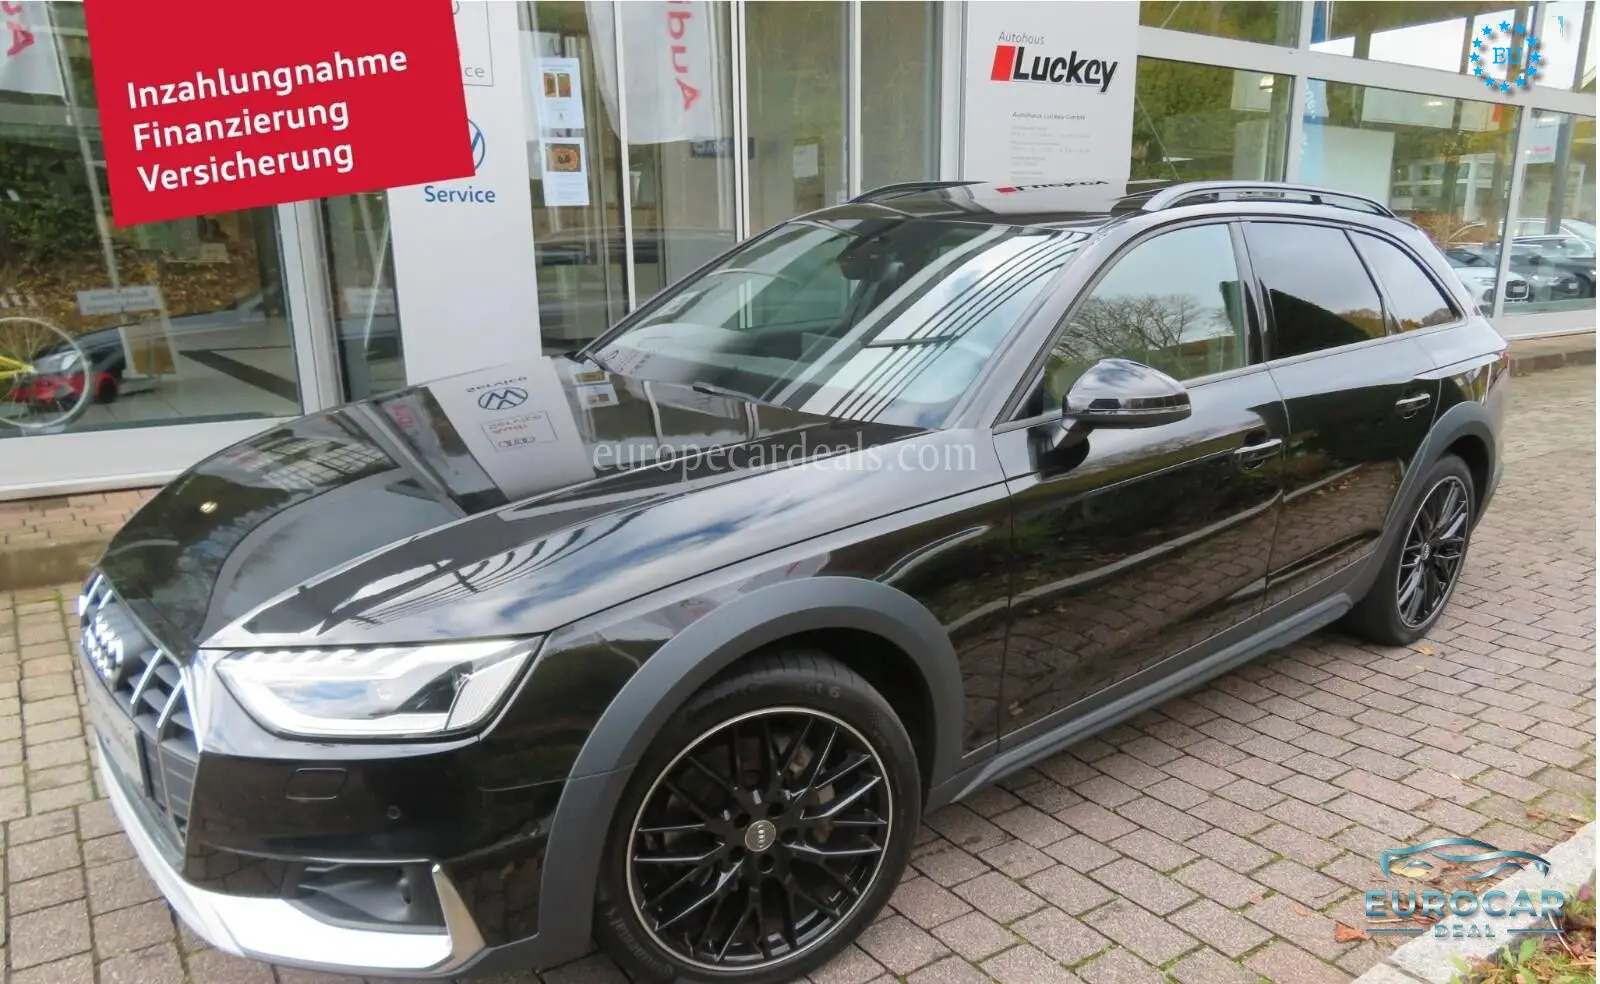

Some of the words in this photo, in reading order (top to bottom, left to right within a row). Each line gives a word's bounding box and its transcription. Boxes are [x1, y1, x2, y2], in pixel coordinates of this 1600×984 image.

[998, 31, 1045, 45] Autohaus
[1012, 46, 1119, 93] Luckey
[424, 185, 496, 203] Service
